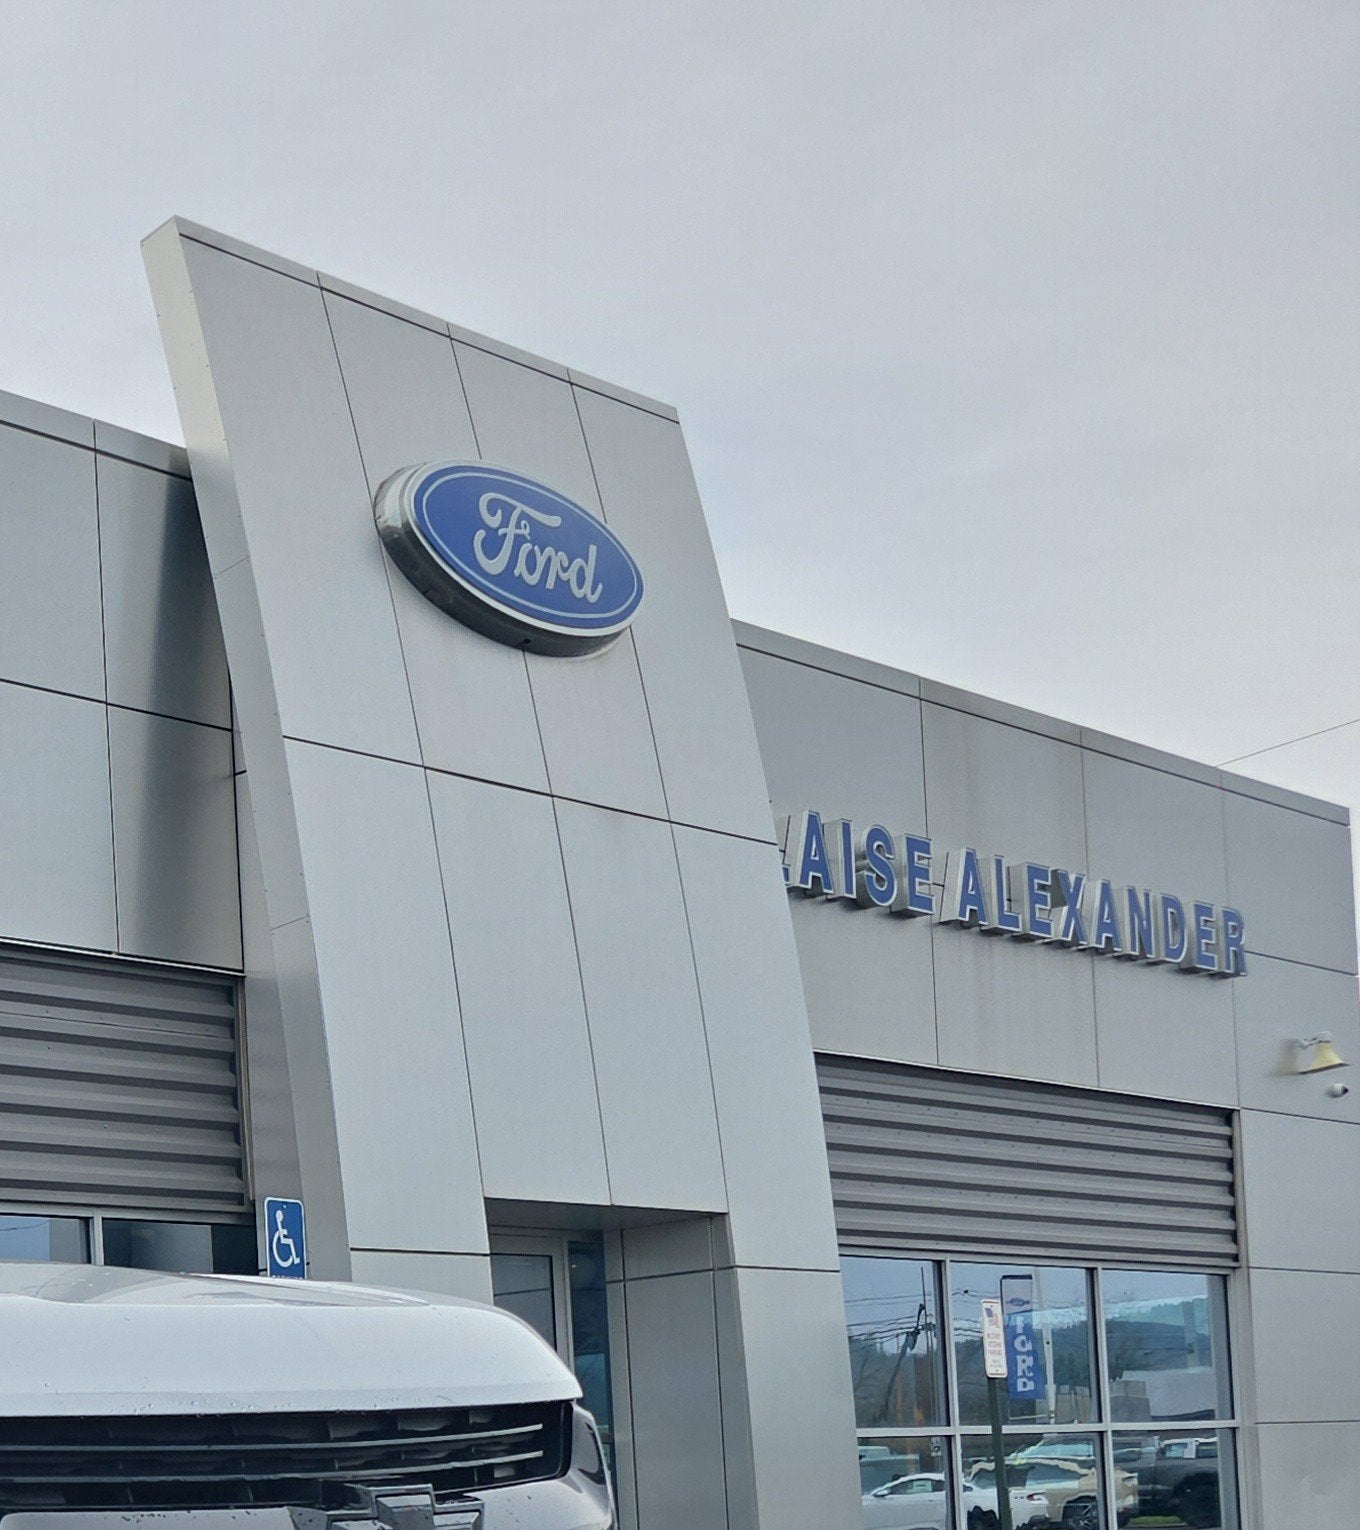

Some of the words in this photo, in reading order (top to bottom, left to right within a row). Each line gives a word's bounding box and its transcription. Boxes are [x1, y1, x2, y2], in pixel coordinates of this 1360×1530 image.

[473, 492, 603, 603] Ford
[781, 809, 935, 916] AISE
[943, 846, 1248, 978] ALEXANDER
